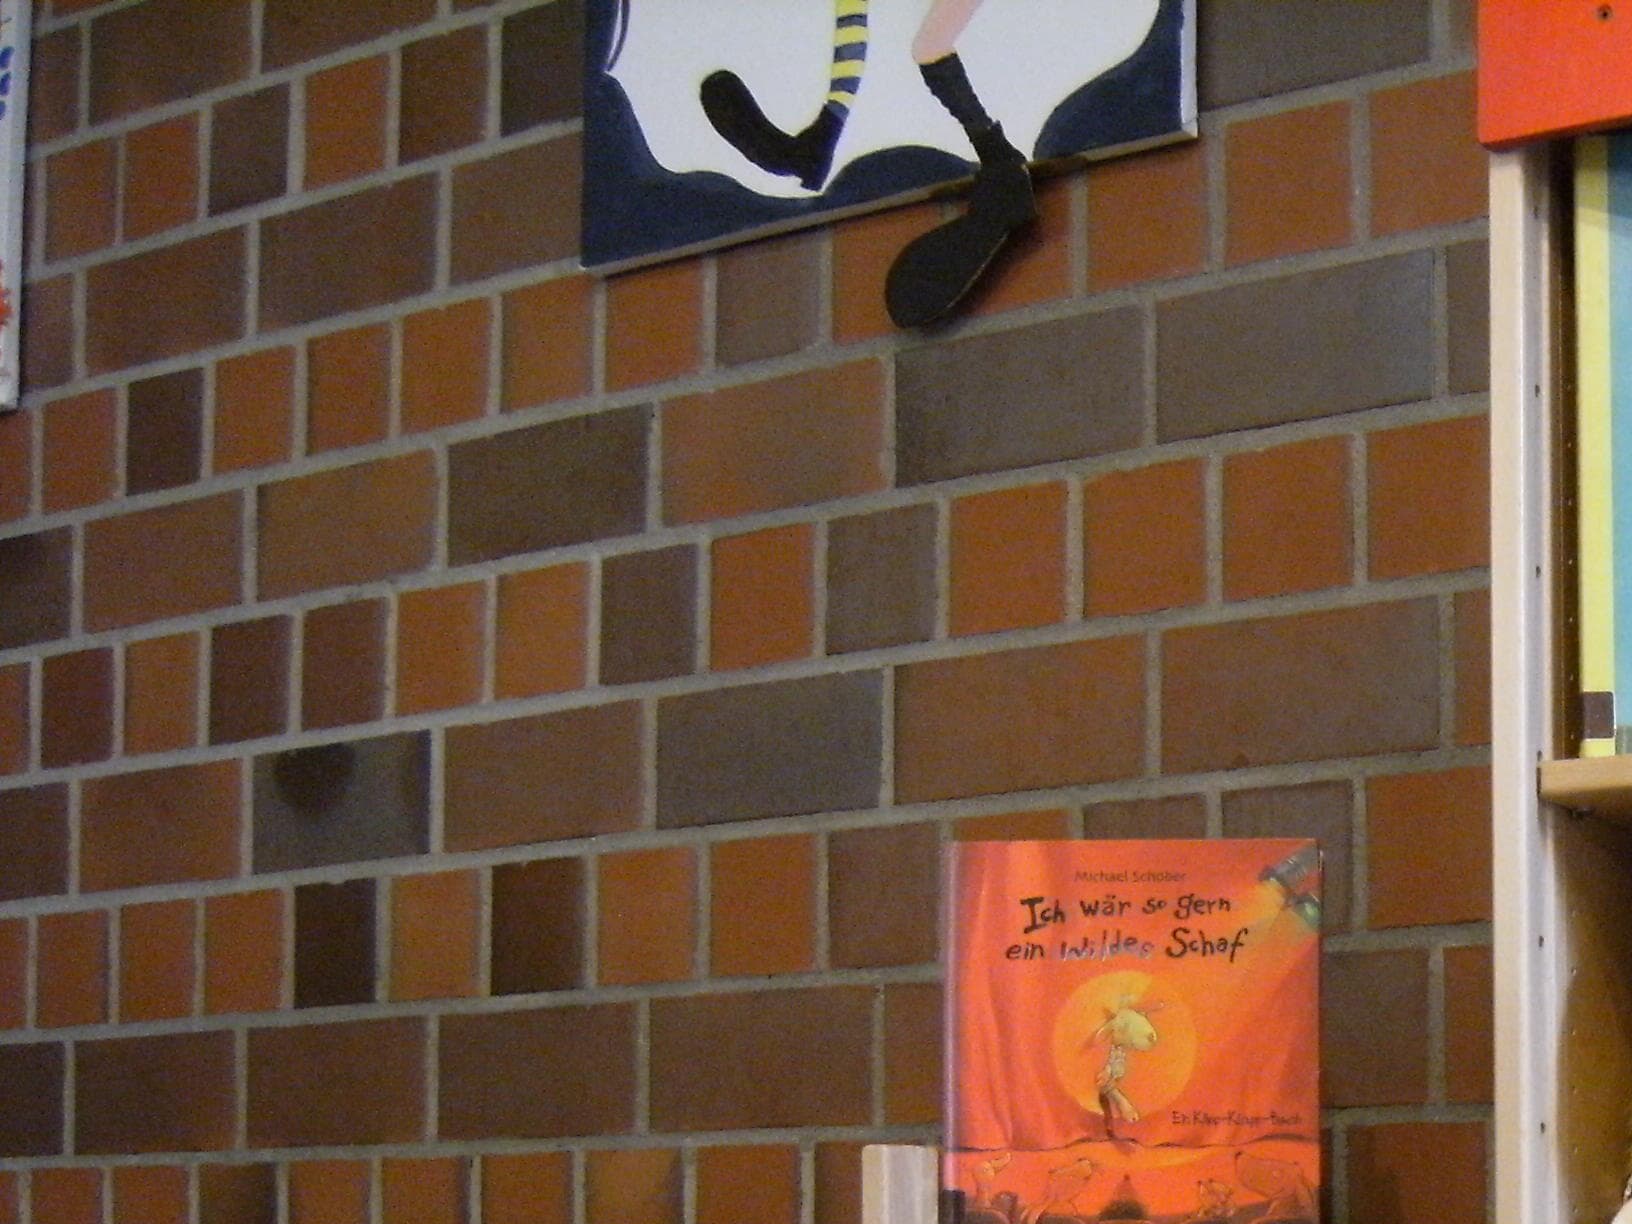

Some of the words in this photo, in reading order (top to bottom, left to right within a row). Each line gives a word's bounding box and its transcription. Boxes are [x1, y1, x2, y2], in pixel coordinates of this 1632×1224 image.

[1020, 896, 1067, 934] Ich
[1080, 894, 1132, 918] wär
[1141, 897, 1168, 915] so
[1173, 893, 1232, 921] gern
[1005, 942, 1046, 961] ein
[1165, 927, 1249, 964] Schaf
